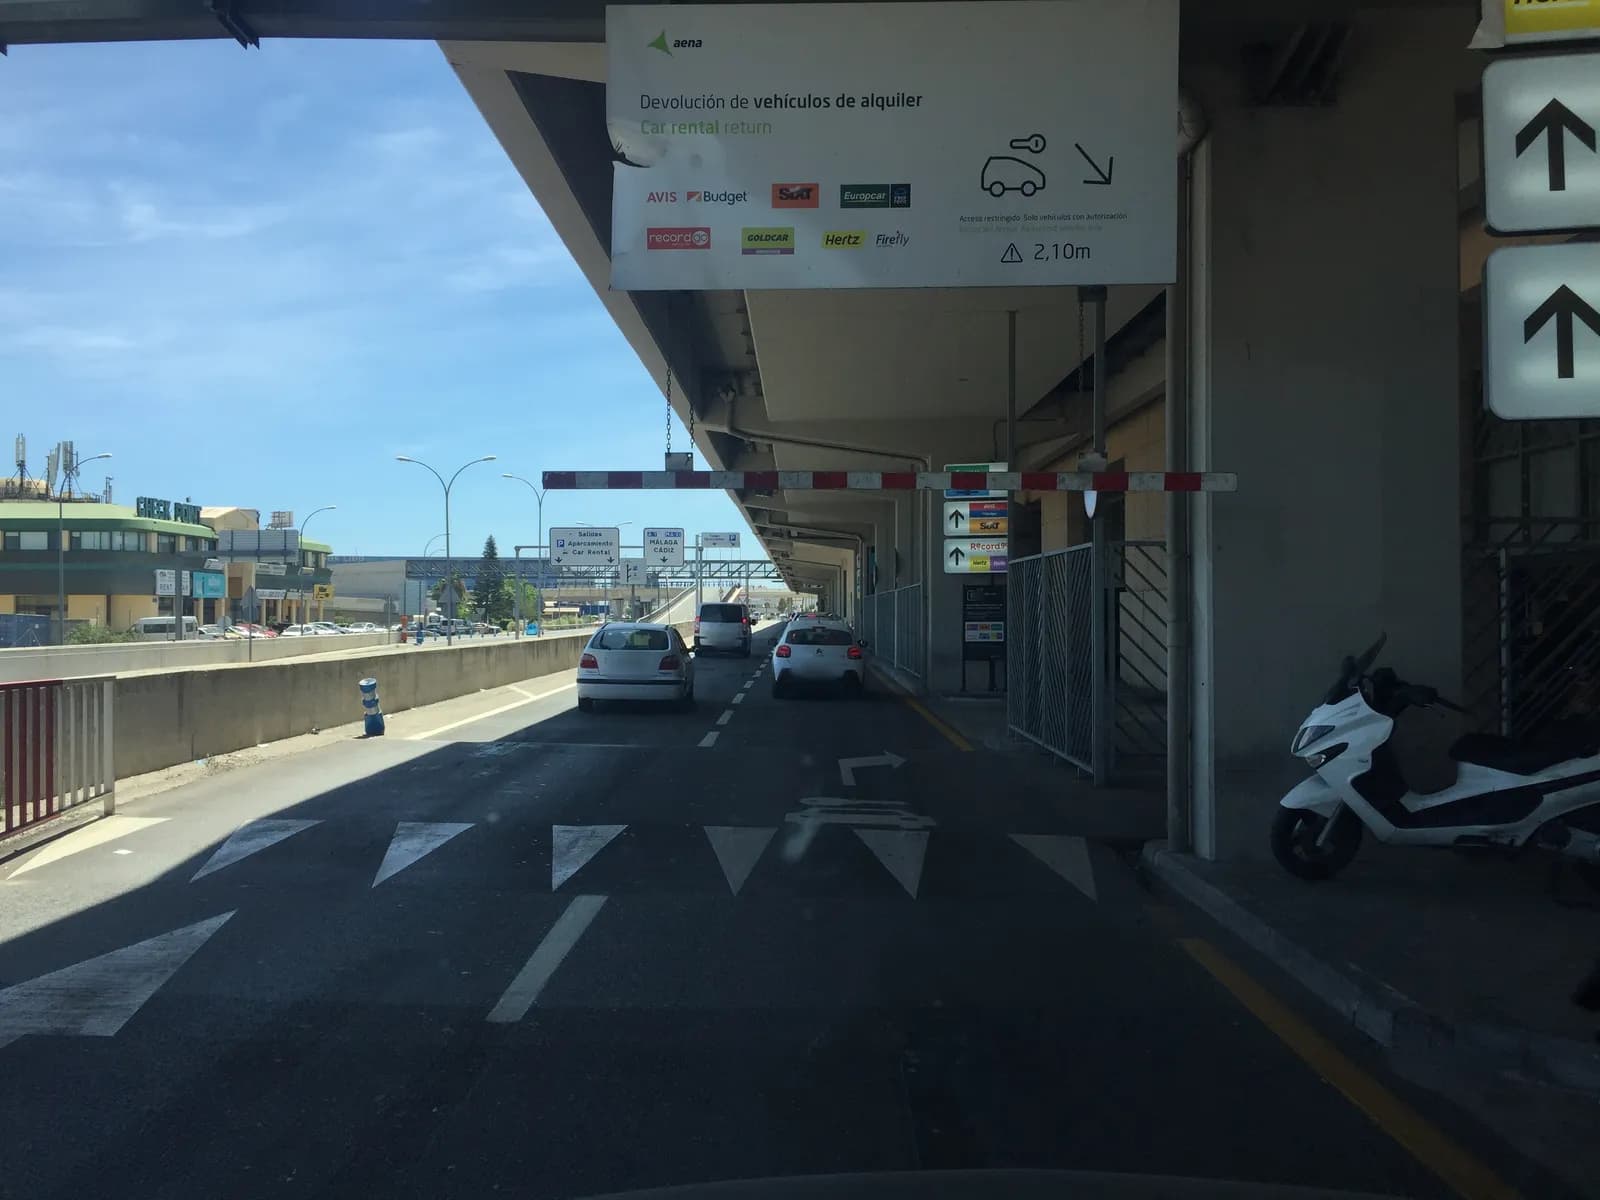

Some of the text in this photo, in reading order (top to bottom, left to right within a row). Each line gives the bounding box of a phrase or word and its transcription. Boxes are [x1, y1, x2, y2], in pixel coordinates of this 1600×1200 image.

[673, 39, 703, 48] aena
[640, 92, 923, 111] Devolución de vehículos de alquiler
[640, 119, 773, 135] Car rental return
[647, 191, 677, 202] AVIS
[703, 191, 748, 206] Budget
[844, 191, 886, 201] Europcar
[747, 234, 789, 242] GOLDCAR
[825, 234, 860, 246] Hertz
[876, 230, 910, 247] Firefly
[1034, 243, 1091, 261] 2,10m
[136, 496, 202, 525] CHECK POINT
